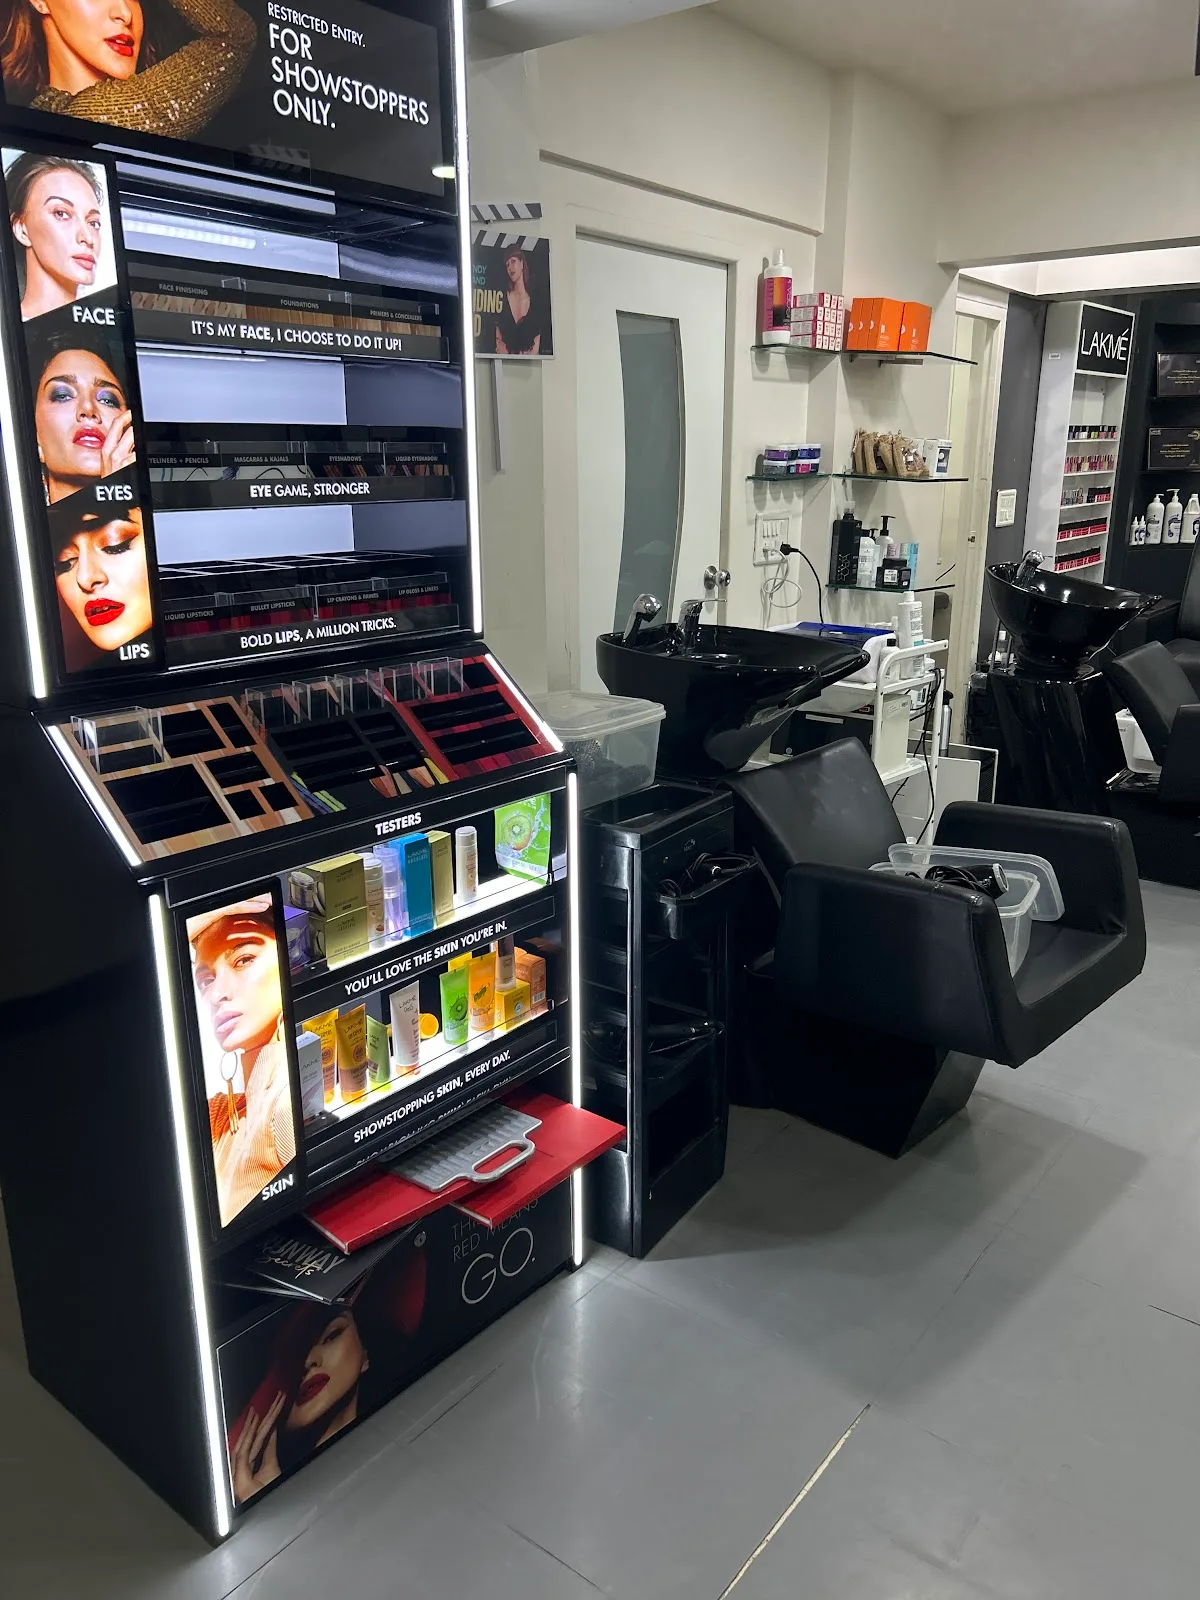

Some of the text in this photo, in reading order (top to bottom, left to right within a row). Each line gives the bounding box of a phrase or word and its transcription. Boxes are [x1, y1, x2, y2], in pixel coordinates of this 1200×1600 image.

[267, 1, 366, 48] RESTRICTED ENTRY.
[269, 23, 313, 61] FOR
[271, 55, 429, 125] SHOWSTOPPERS
[273, 89, 336, 129] ONLY.
[159, 283, 208, 296] FACE FINISHING
[72, 305, 116, 326] FACE
[280, 299, 320, 310] FOUNDATIONS
[191, 320, 402, 351] IT'S MY FACE, I CHOOSE TO DO IT UP!
[1080, 328, 1129, 361] LAKMÉ
[185, 456, 209, 464] PENCILS
[95, 485, 133, 501] EYES
[250, 482, 370, 499] EYE GAME, STRONGER
[165, 610, 214, 621] LIQUID LIPSTICKS
[250, 600, 295, 612] BULLET LIPSTICKS
[240, 616, 397, 649] BOLD LIPS, A MILLION TRICKS.
[119, 642, 150, 661] LIPS
[374, 812, 422, 836] TESTERS
[344, 920, 507, 996] YOU'LL LOVE THE SKIN YOU'RE IN.
[353, 1091, 435, 1143] SHOWSTOPPING
[436, 1076, 464, 1098] SKIN,
[465, 1062, 491, 1083] EVERY
[492, 1049, 511, 1067] DAY.
[261, 1173, 294, 1201] SKIN
[453, 1232, 481, 1262] RED
[461, 1227, 536, 1304] GO.
